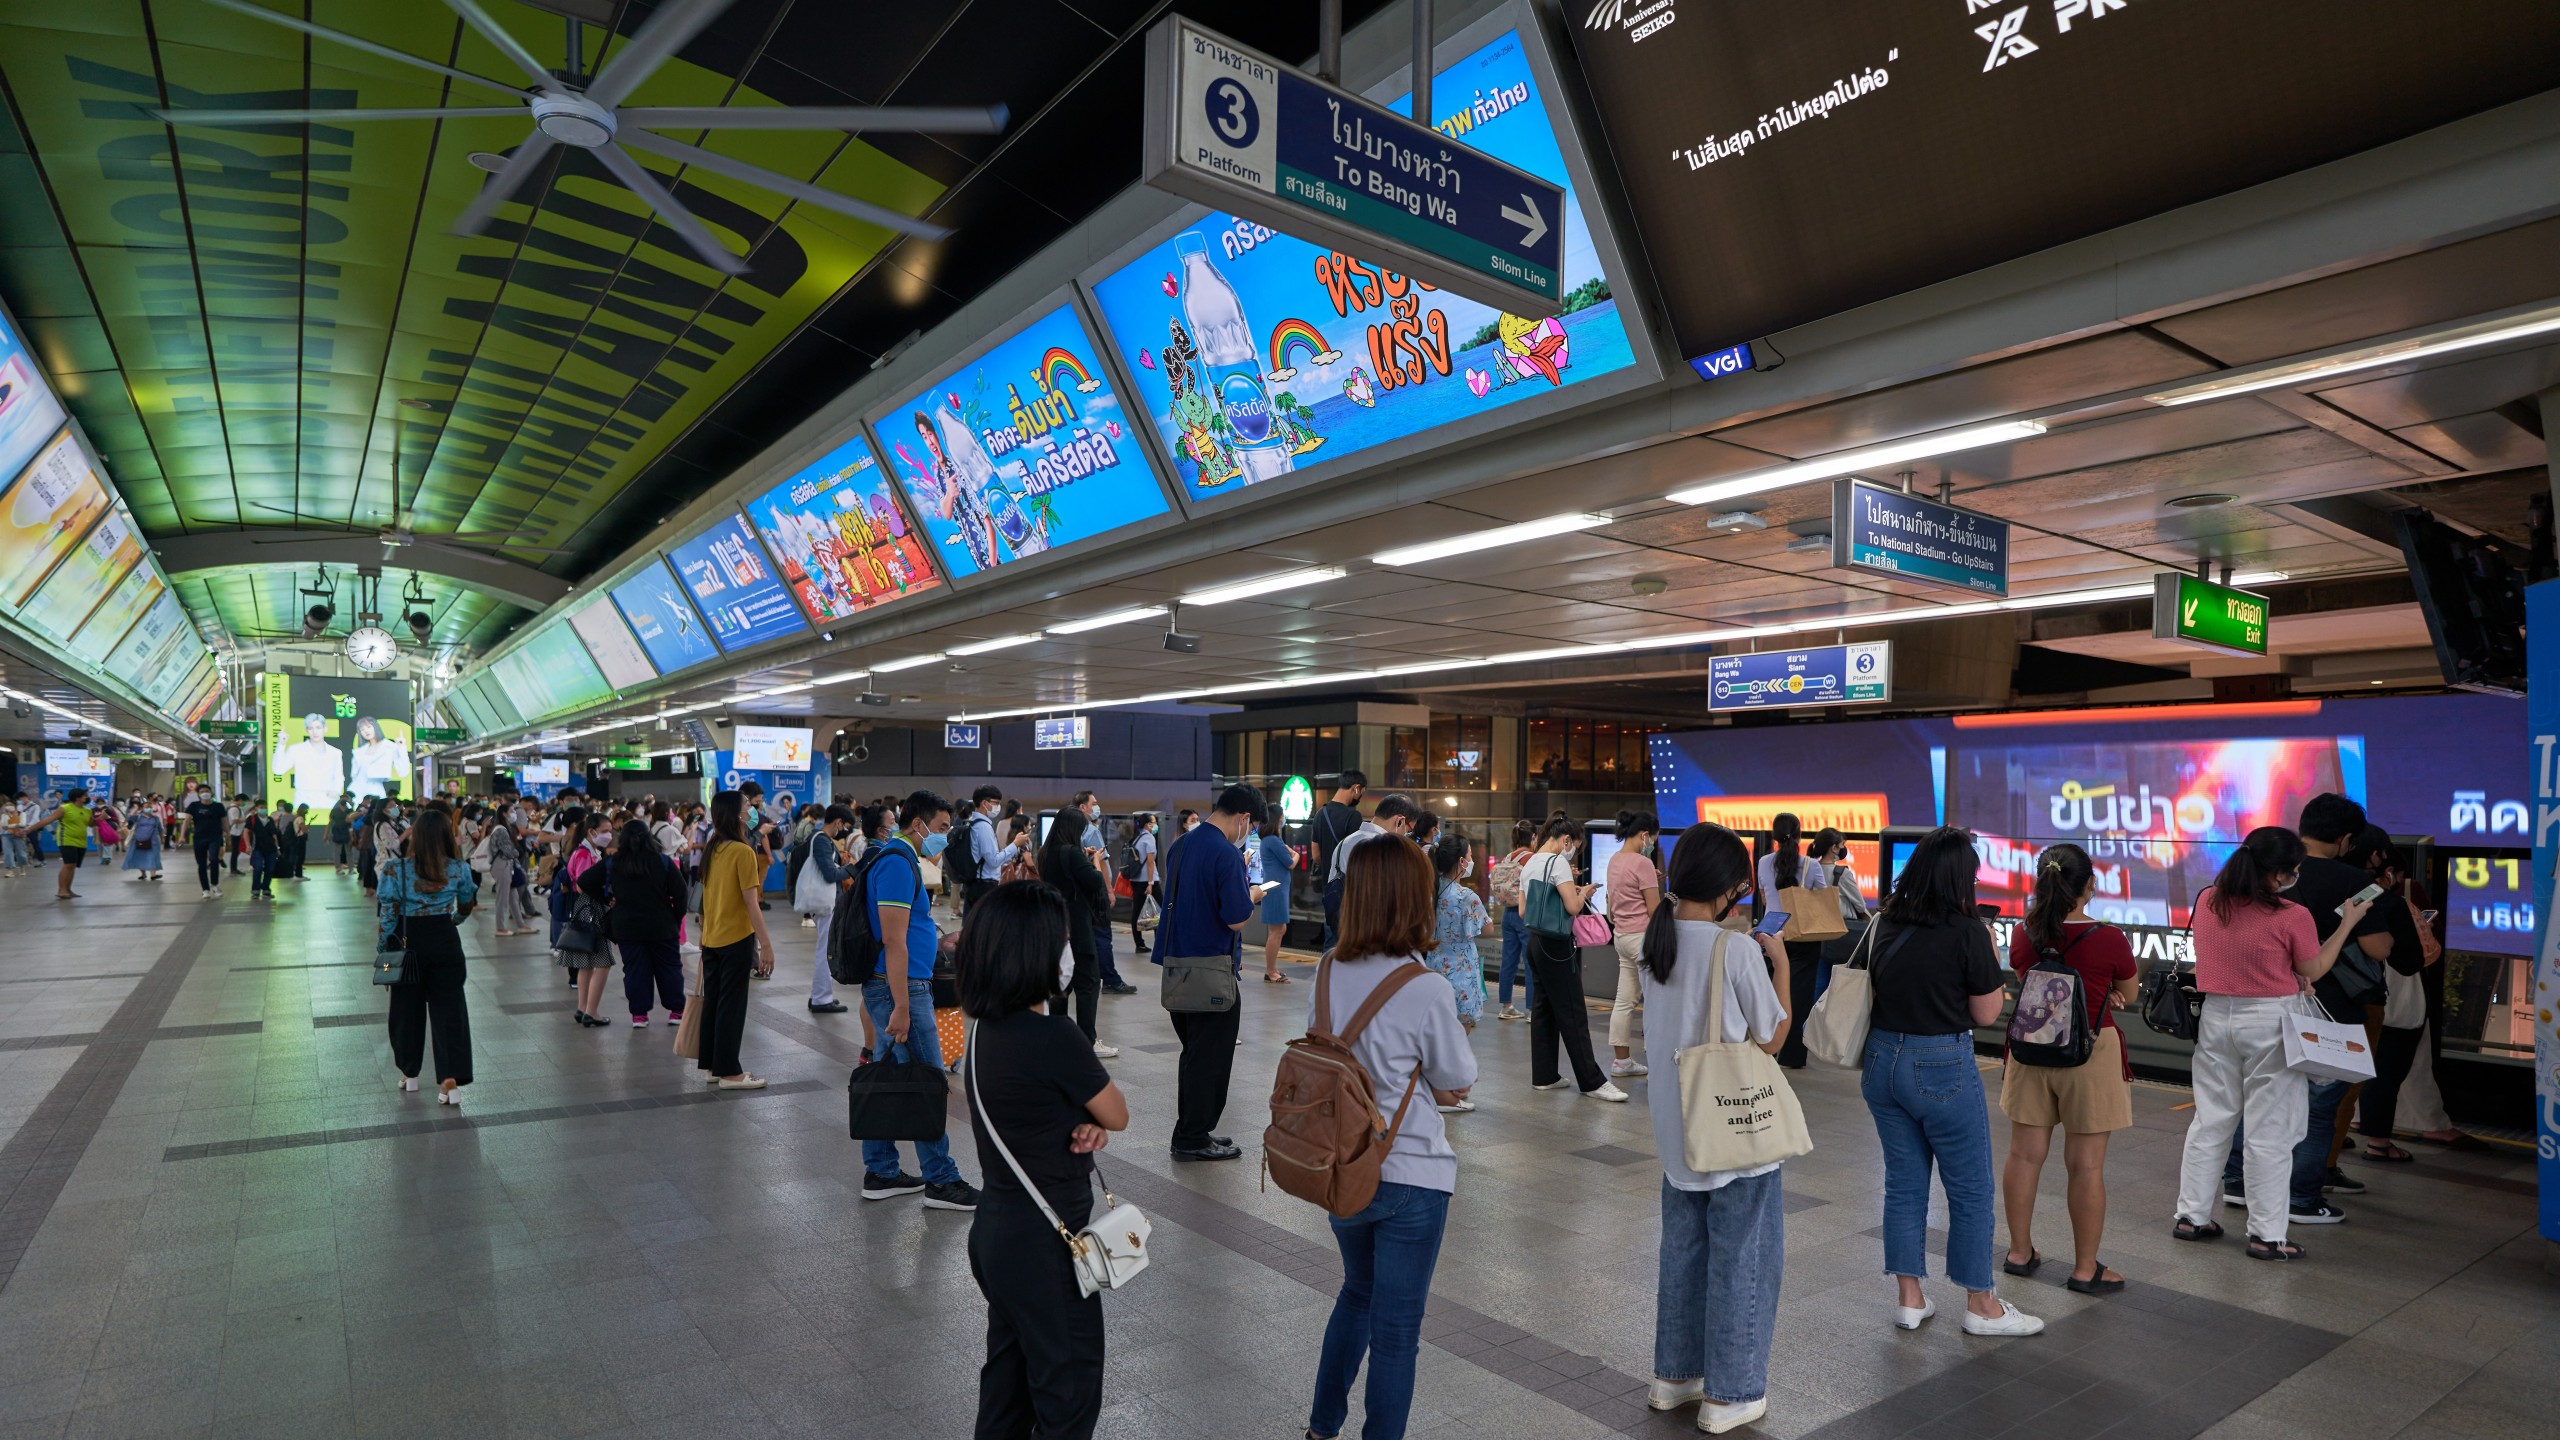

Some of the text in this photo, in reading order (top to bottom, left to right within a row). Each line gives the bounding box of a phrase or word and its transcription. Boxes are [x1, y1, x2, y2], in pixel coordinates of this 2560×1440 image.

[1631, 10, 1675, 43] SEIKO
[1193, 37, 1274, 85] ชานชาลา
[1217, 83, 1248, 140] 3
[1327, 97, 1461, 194] ไปบางหว้า
[1198, 147, 1261, 183] Platform
[1285, 176, 1347, 211] สายสีลม
[1334, 155, 1457, 226] To Bang Wa
[1491, 255, 1547, 288] Silom Line
[1864, 551, 1898, 570] สายสีลม
[1868, 531, 1879, 546] To
[1880, 534, 1914, 554] National
[1915, 543, 1946, 561] Stadium
[1951, 552, 1963, 566] Go
[1964, 554, 1994, 572] UpStairs
[1969, 577, 1997, 591] Silom Line
[2227, 597, 2262, 626] ทางออก
[2246, 626, 2261, 645] Exit
[1715, 658, 1742, 670] บางหว้า
[1786, 653, 1808, 664] สยาม
[1788, 663, 1806, 672] Siam
[1859, 654, 1871, 672] 3
[1715, 670, 1740, 679] Bang Wa
[1825, 678, 1835, 686] W1
[1717, 686, 1728, 694] S12
[271, 683, 282, 727] NETWORK
[335, 701, 357, 718] 5G
[1714, 1085, 1775, 1109] Young wild
[1727, 1108, 1774, 1126] and free
